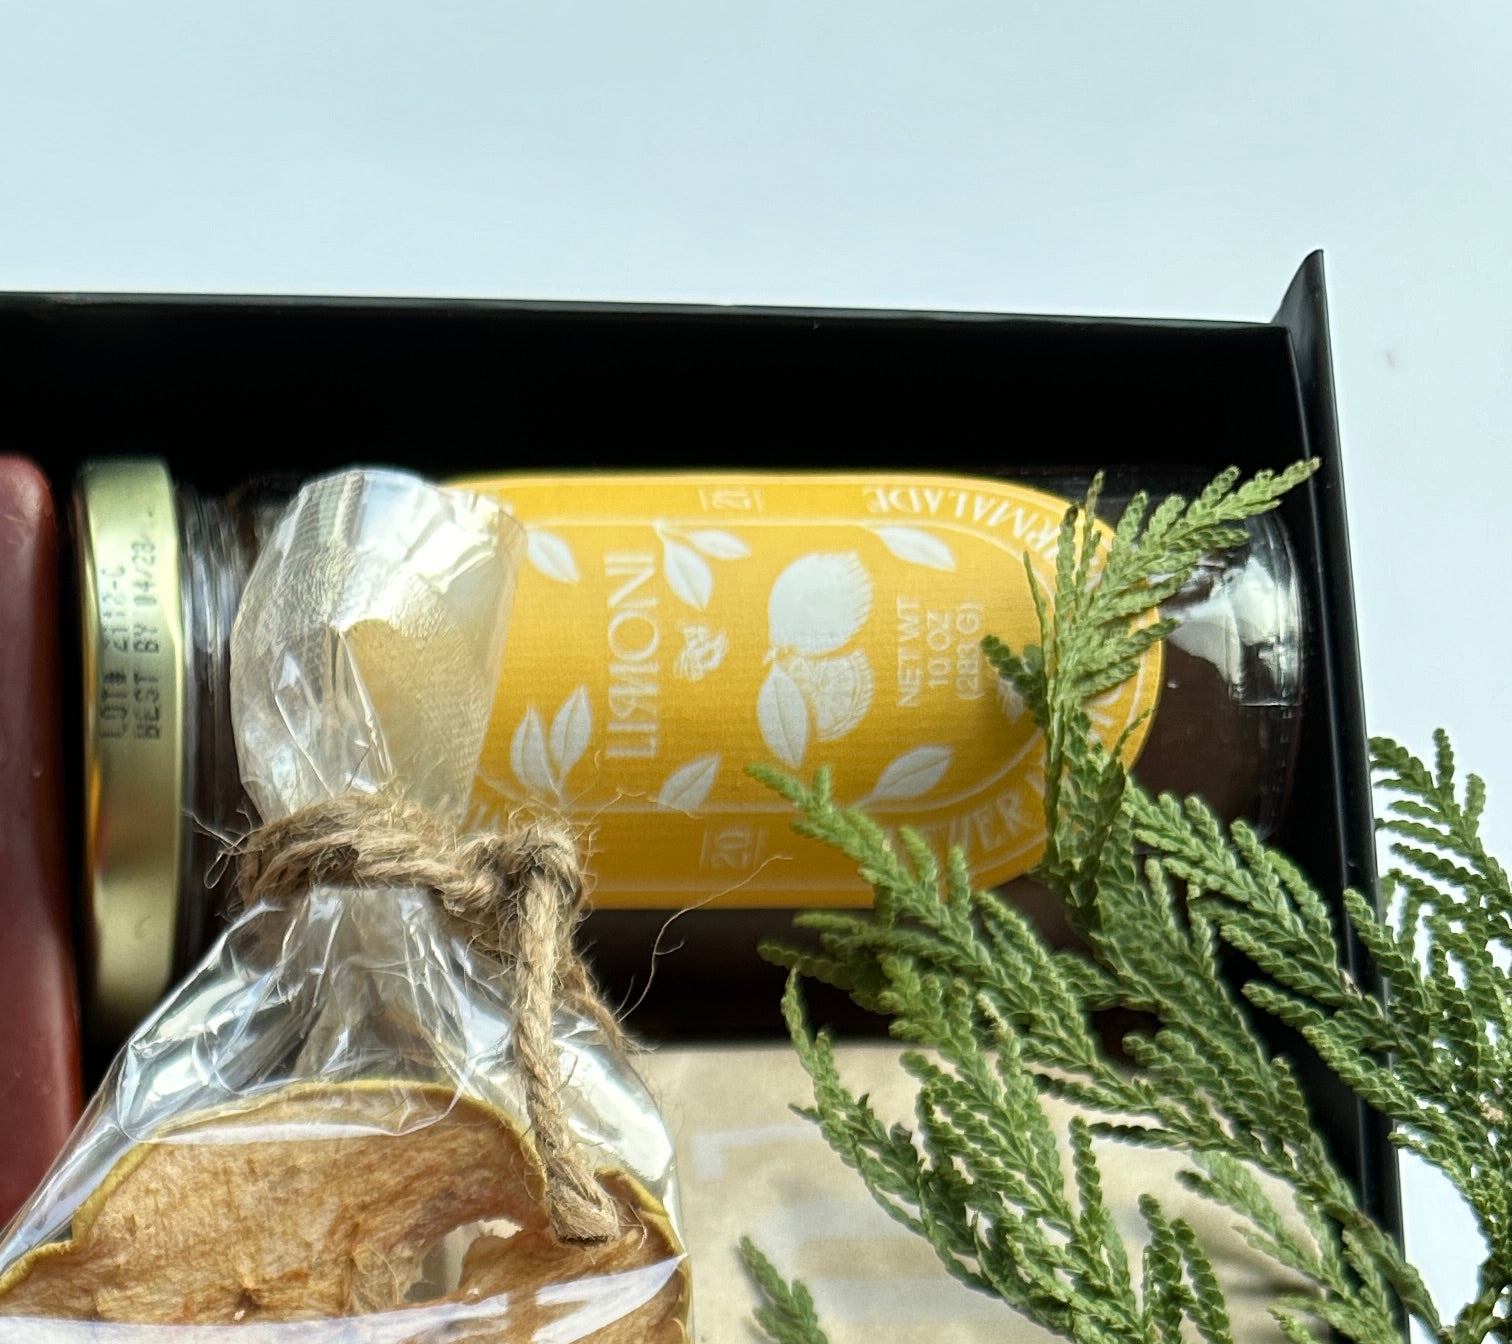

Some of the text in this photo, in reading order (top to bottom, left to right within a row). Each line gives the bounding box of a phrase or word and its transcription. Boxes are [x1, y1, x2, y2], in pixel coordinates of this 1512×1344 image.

[864, 486, 1062, 560] RMALADE
[134, 623, 159, 653] BY
[896, 595, 921, 708] NET WT
[928, 609, 951, 688] 10 OZ
[134, 671, 160, 738] BEST
